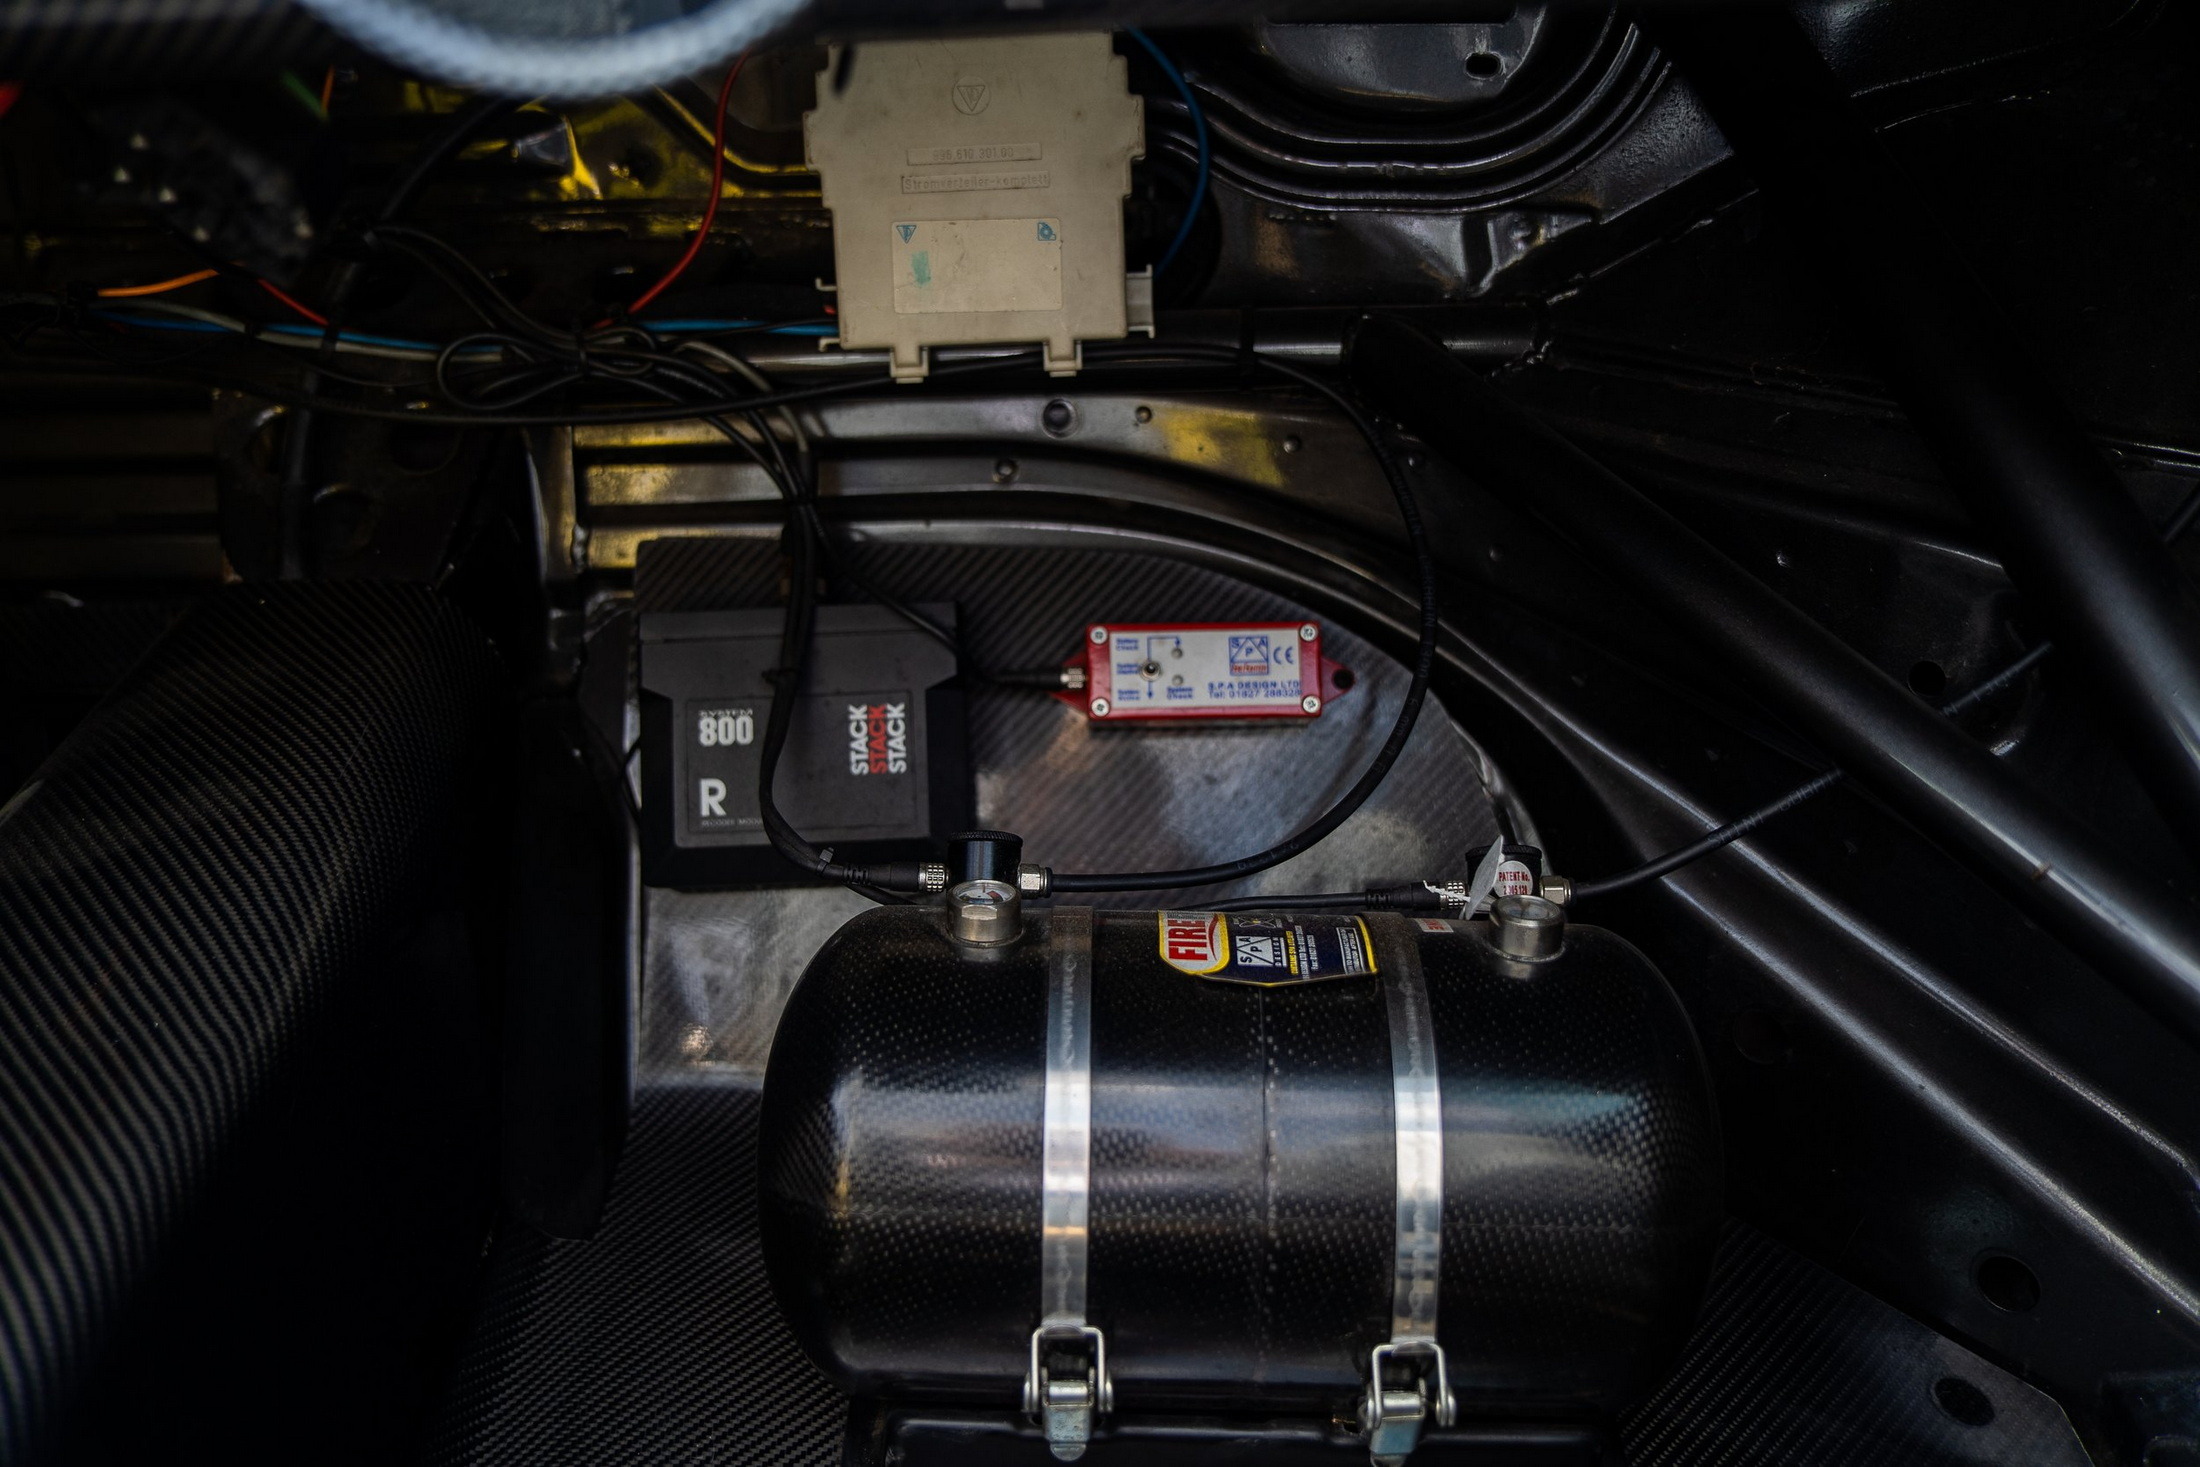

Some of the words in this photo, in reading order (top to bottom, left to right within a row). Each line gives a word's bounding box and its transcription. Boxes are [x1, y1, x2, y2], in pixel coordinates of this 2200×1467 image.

[1229, 689, 1260, 699] 01827
[1237, 680, 1277, 690] DESIGN
[1280, 679, 1299, 688] LTD
[699, 707, 754, 718] SYSTEM
[698, 715, 755, 747] 800
[849, 703, 869, 776] STACK
[868, 703, 888, 775] STACK
[886, 701, 907, 774] STACK
[700, 777, 727, 817] R
[1498, 871, 1521, 882] PATENT
[1167, 919, 1209, 962] FIRE
[1272, 937, 1283, 967] DESIGN
